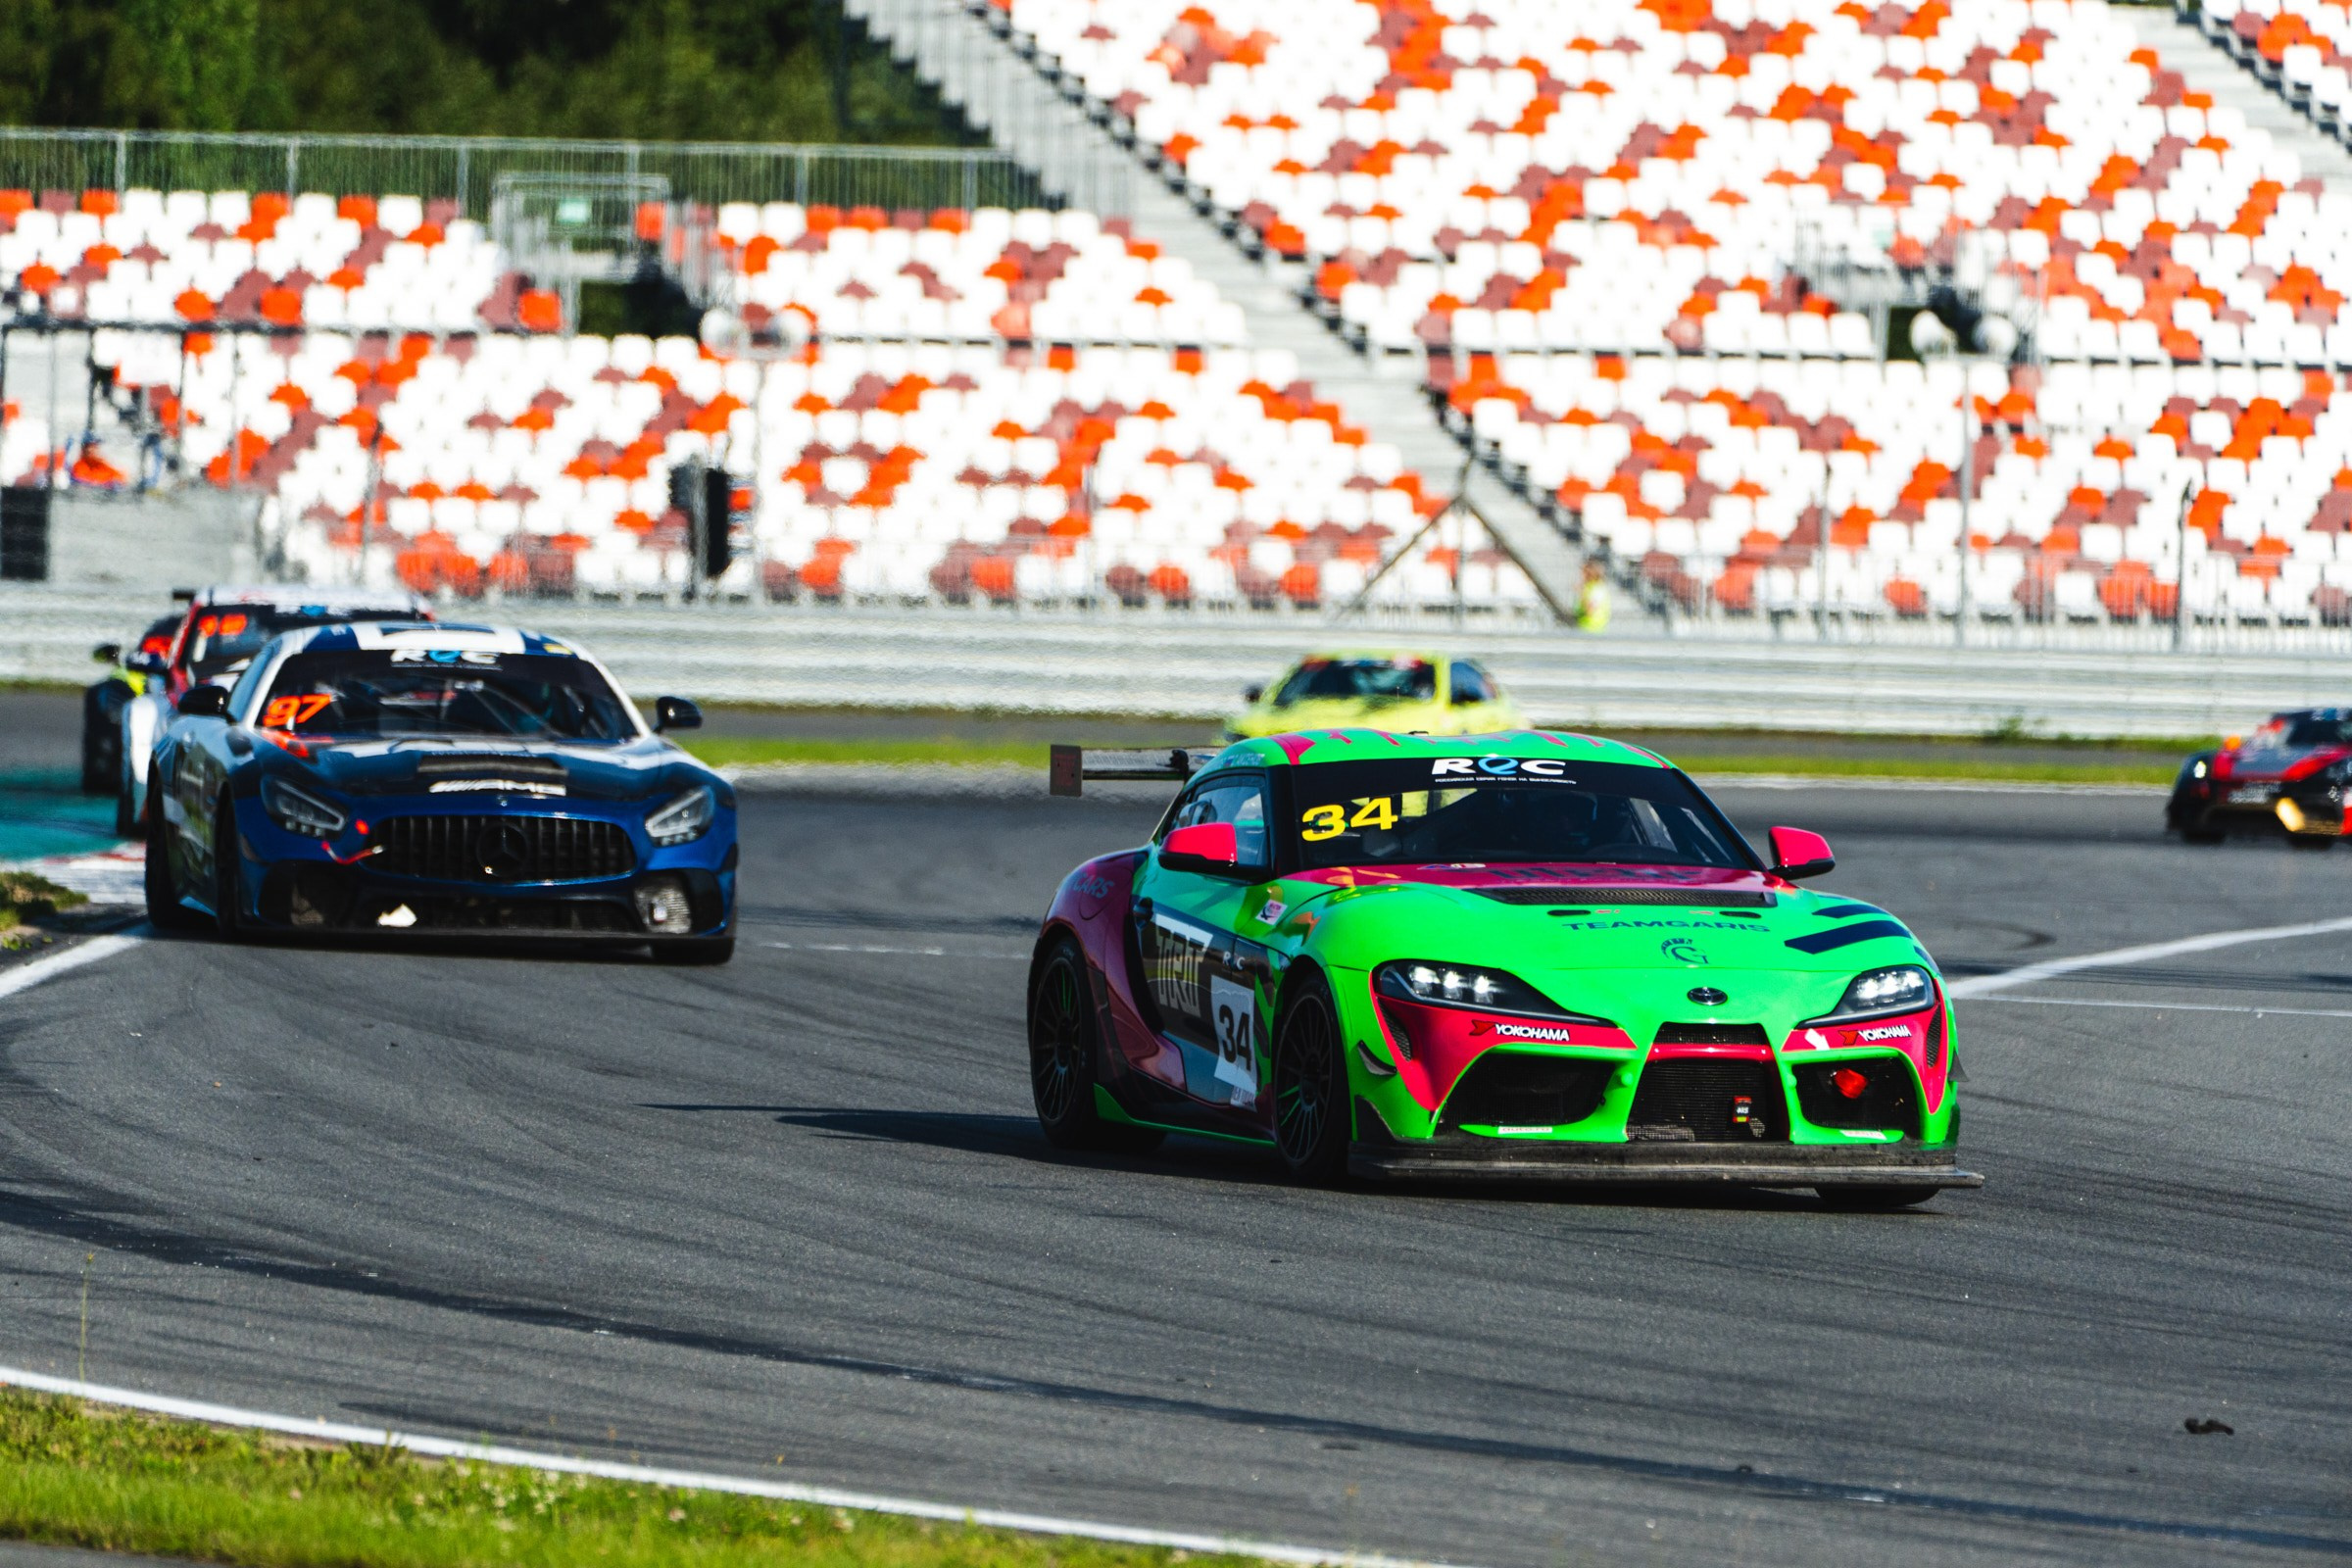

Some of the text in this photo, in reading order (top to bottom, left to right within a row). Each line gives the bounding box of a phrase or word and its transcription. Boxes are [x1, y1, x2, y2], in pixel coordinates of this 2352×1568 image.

[263, 693, 331, 727] 97
[474, 779, 566, 797] AMG
[1301, 797, 1398, 842] 34
[1219, 1004, 1251, 1071] 34
[1494, 1024, 1570, 1041] YOKOHAMA
[1858, 1024, 1912, 1041] YOKOHAMA
